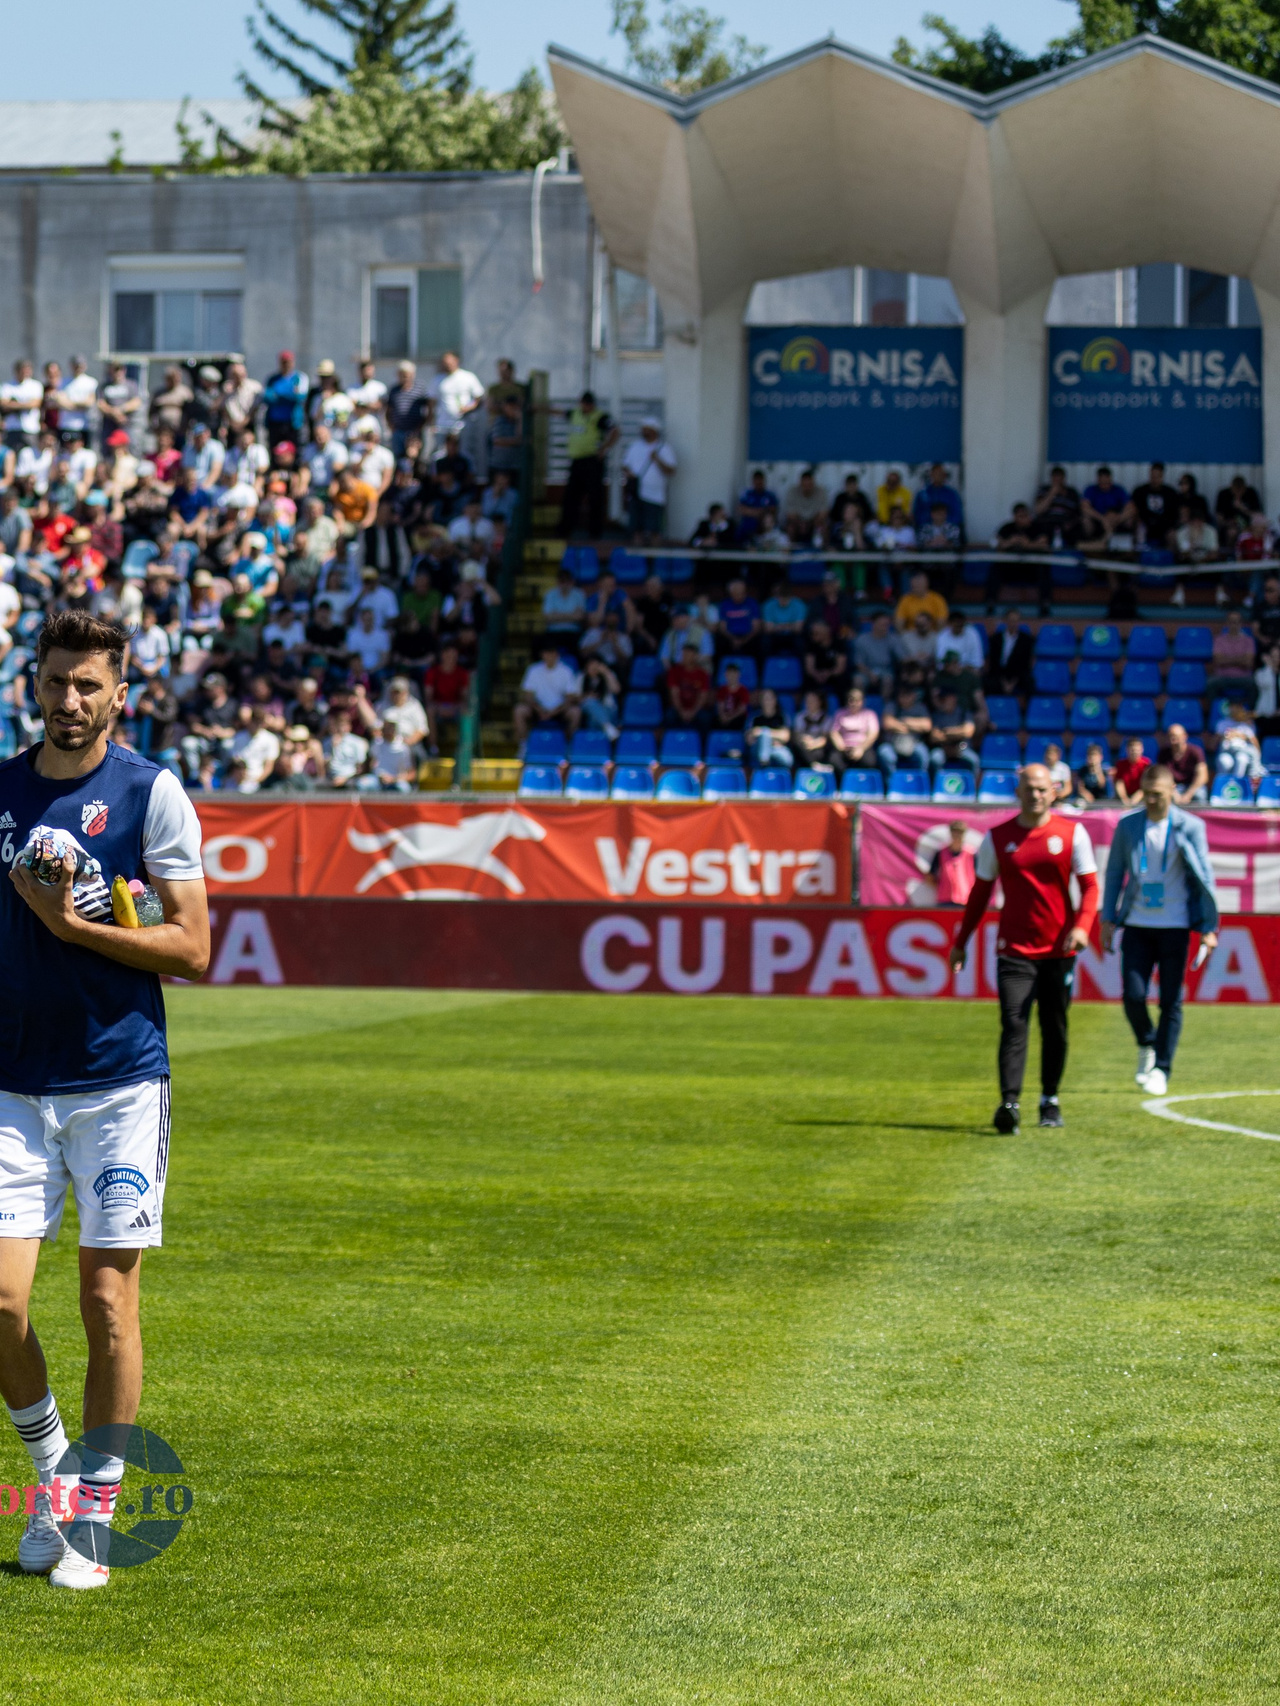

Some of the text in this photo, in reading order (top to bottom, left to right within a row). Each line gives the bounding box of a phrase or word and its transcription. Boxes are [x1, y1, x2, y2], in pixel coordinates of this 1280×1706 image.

[595, 836, 836, 897] Vestra
[581, 915, 727, 993] CU
[95, 1170, 147, 1193] FIVE CONTINENTS
